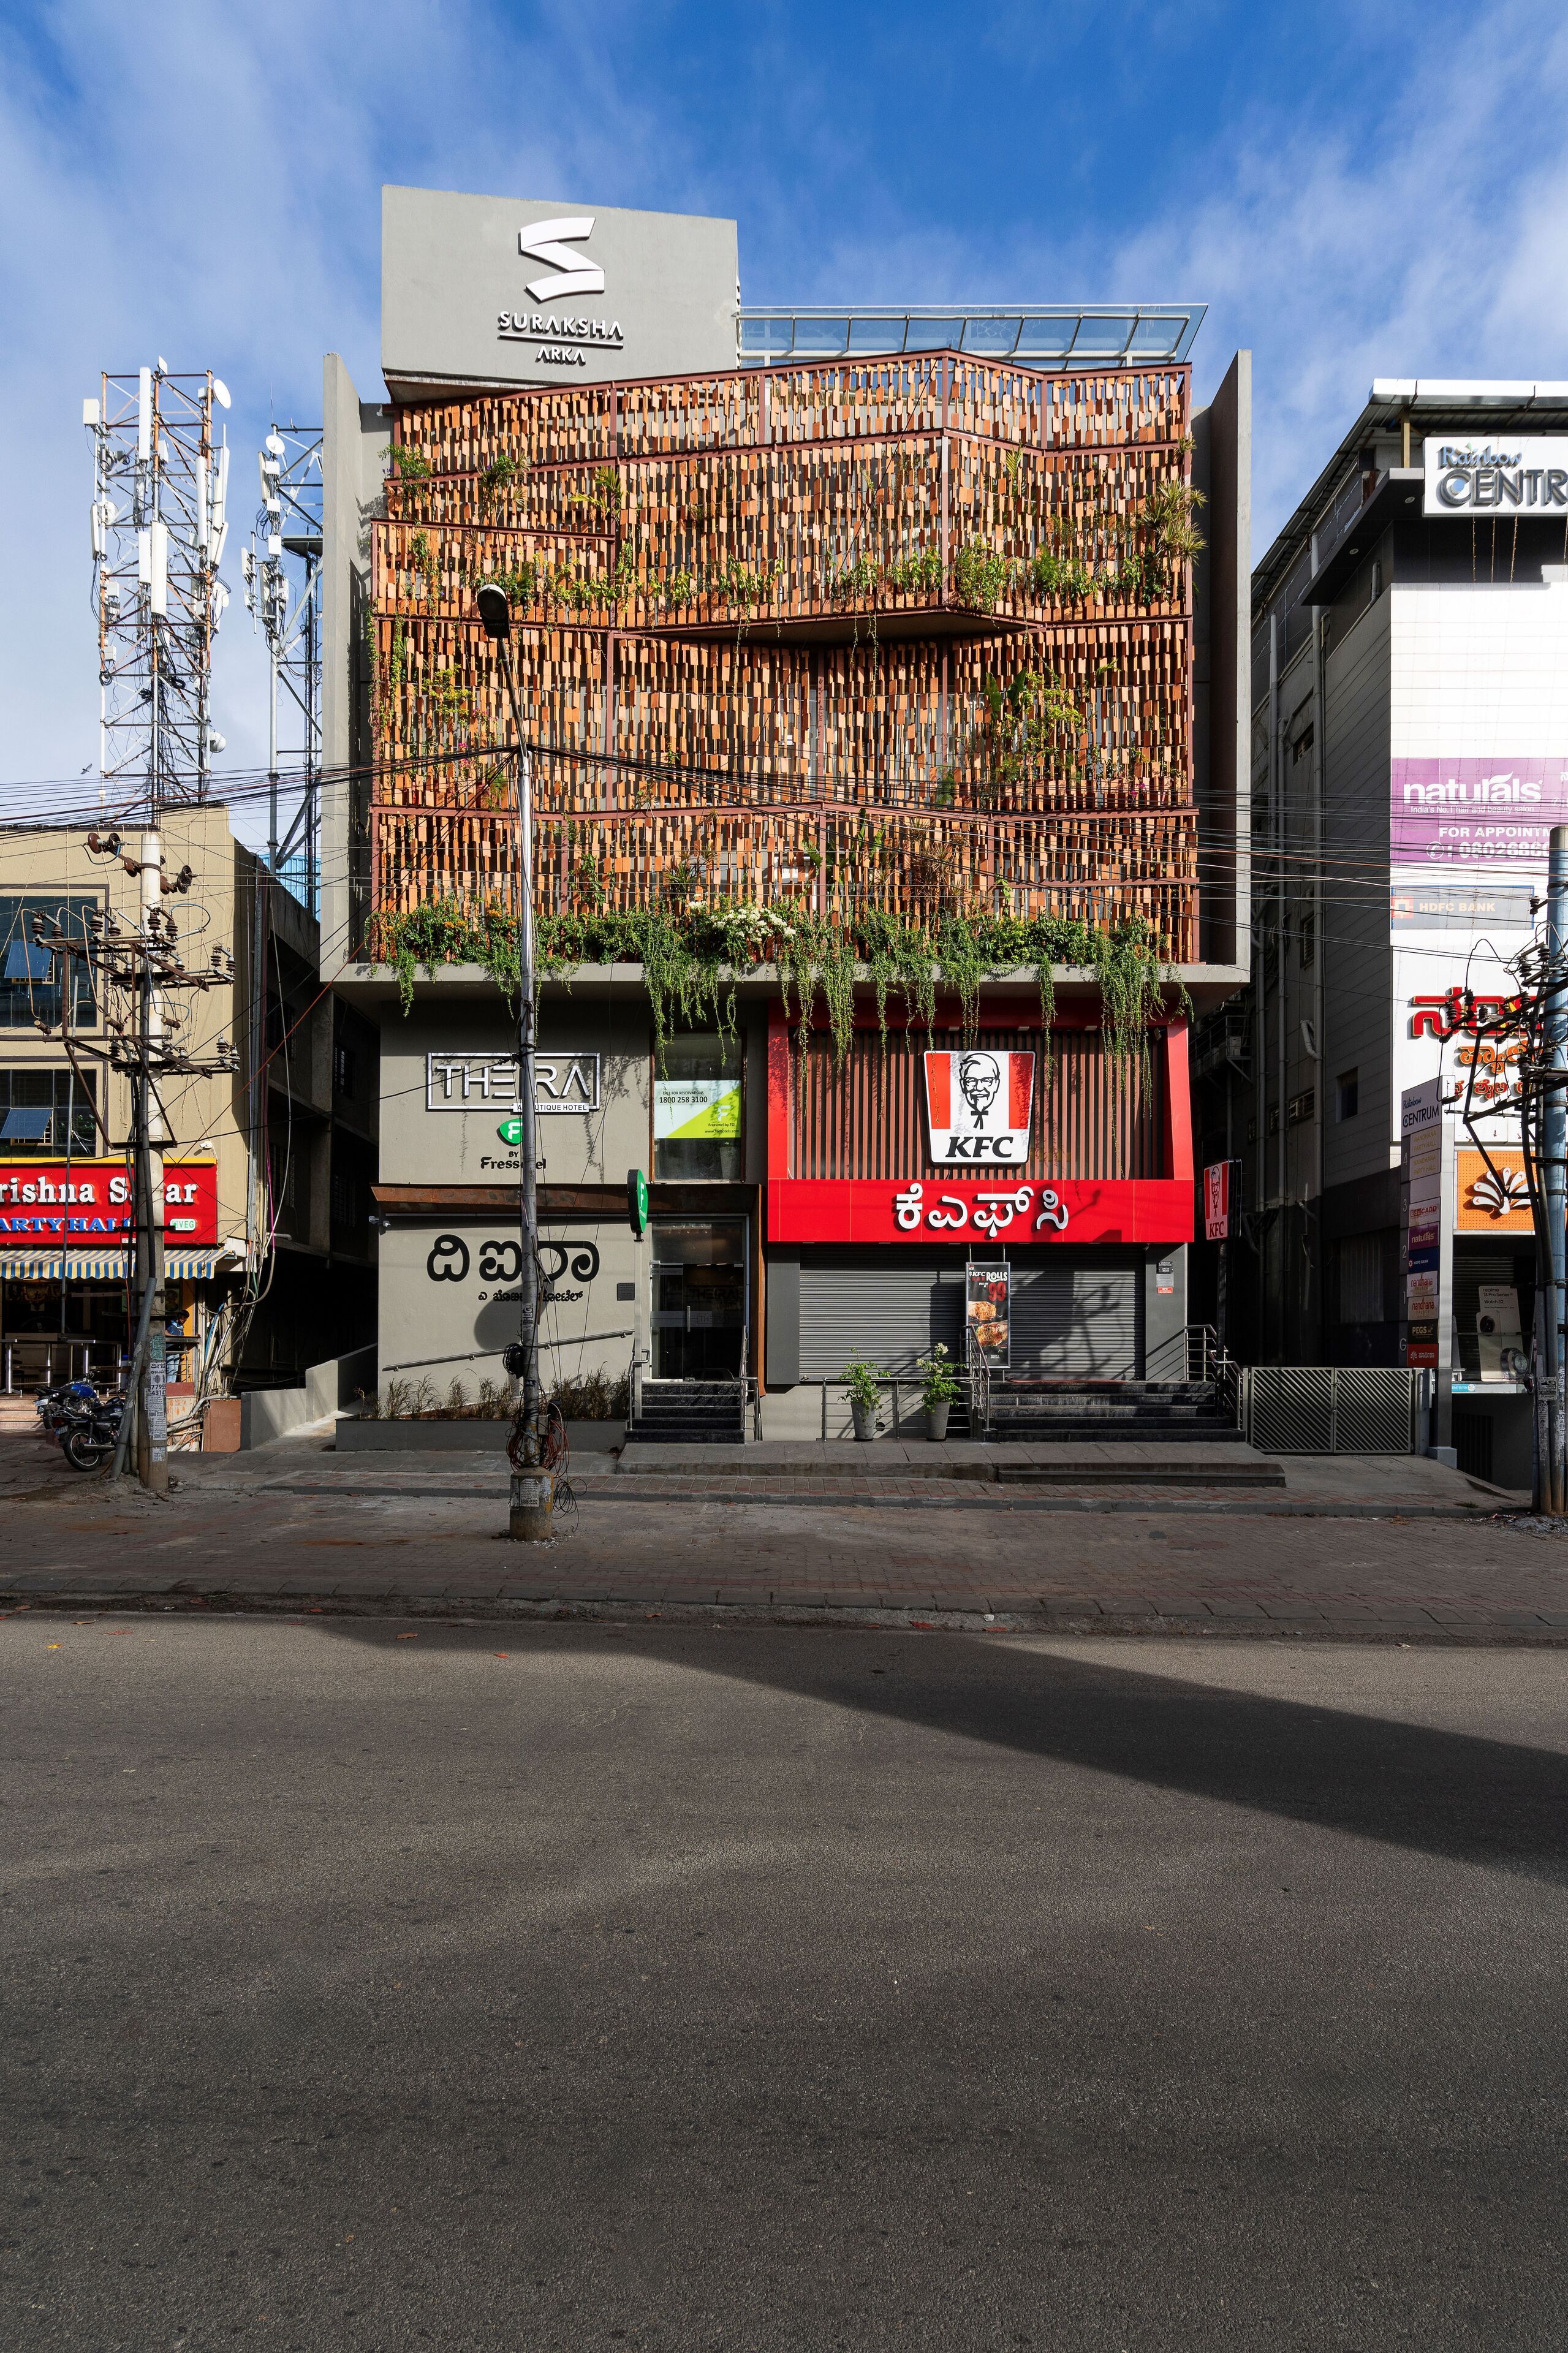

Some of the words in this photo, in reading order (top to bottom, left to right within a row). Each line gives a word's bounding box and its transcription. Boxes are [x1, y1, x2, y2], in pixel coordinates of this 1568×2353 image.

[498, 310, 624, 340] SURAKSHA
[535, 345, 586, 366] ARKA
[1438, 445, 1523, 470] Rainbow
[1403, 771, 1541, 805] naturals
[1487, 806, 1512, 814] beauty
[1439, 827, 1470, 837] FOR
[1419, 902, 1455, 912] HDFC
[1458, 902, 1496, 912] BANK
[1403, 1097, 1422, 1110] Rainbow
[1403, 1104, 1439, 1128] CENTRUM
[945, 1136, 1013, 1158] KFC
[1403, 1153, 1407, 1165] 4
[1403, 1199, 1407, 1212] 3
[1209, 1221, 1224, 1238] KFC
[1411, 1232, 1434, 1243] naturals
[1402, 1245, 1407, 1259] 2
[986, 1271, 1008, 1282] ROLLS
[988, 1282, 1006, 1302] 99
